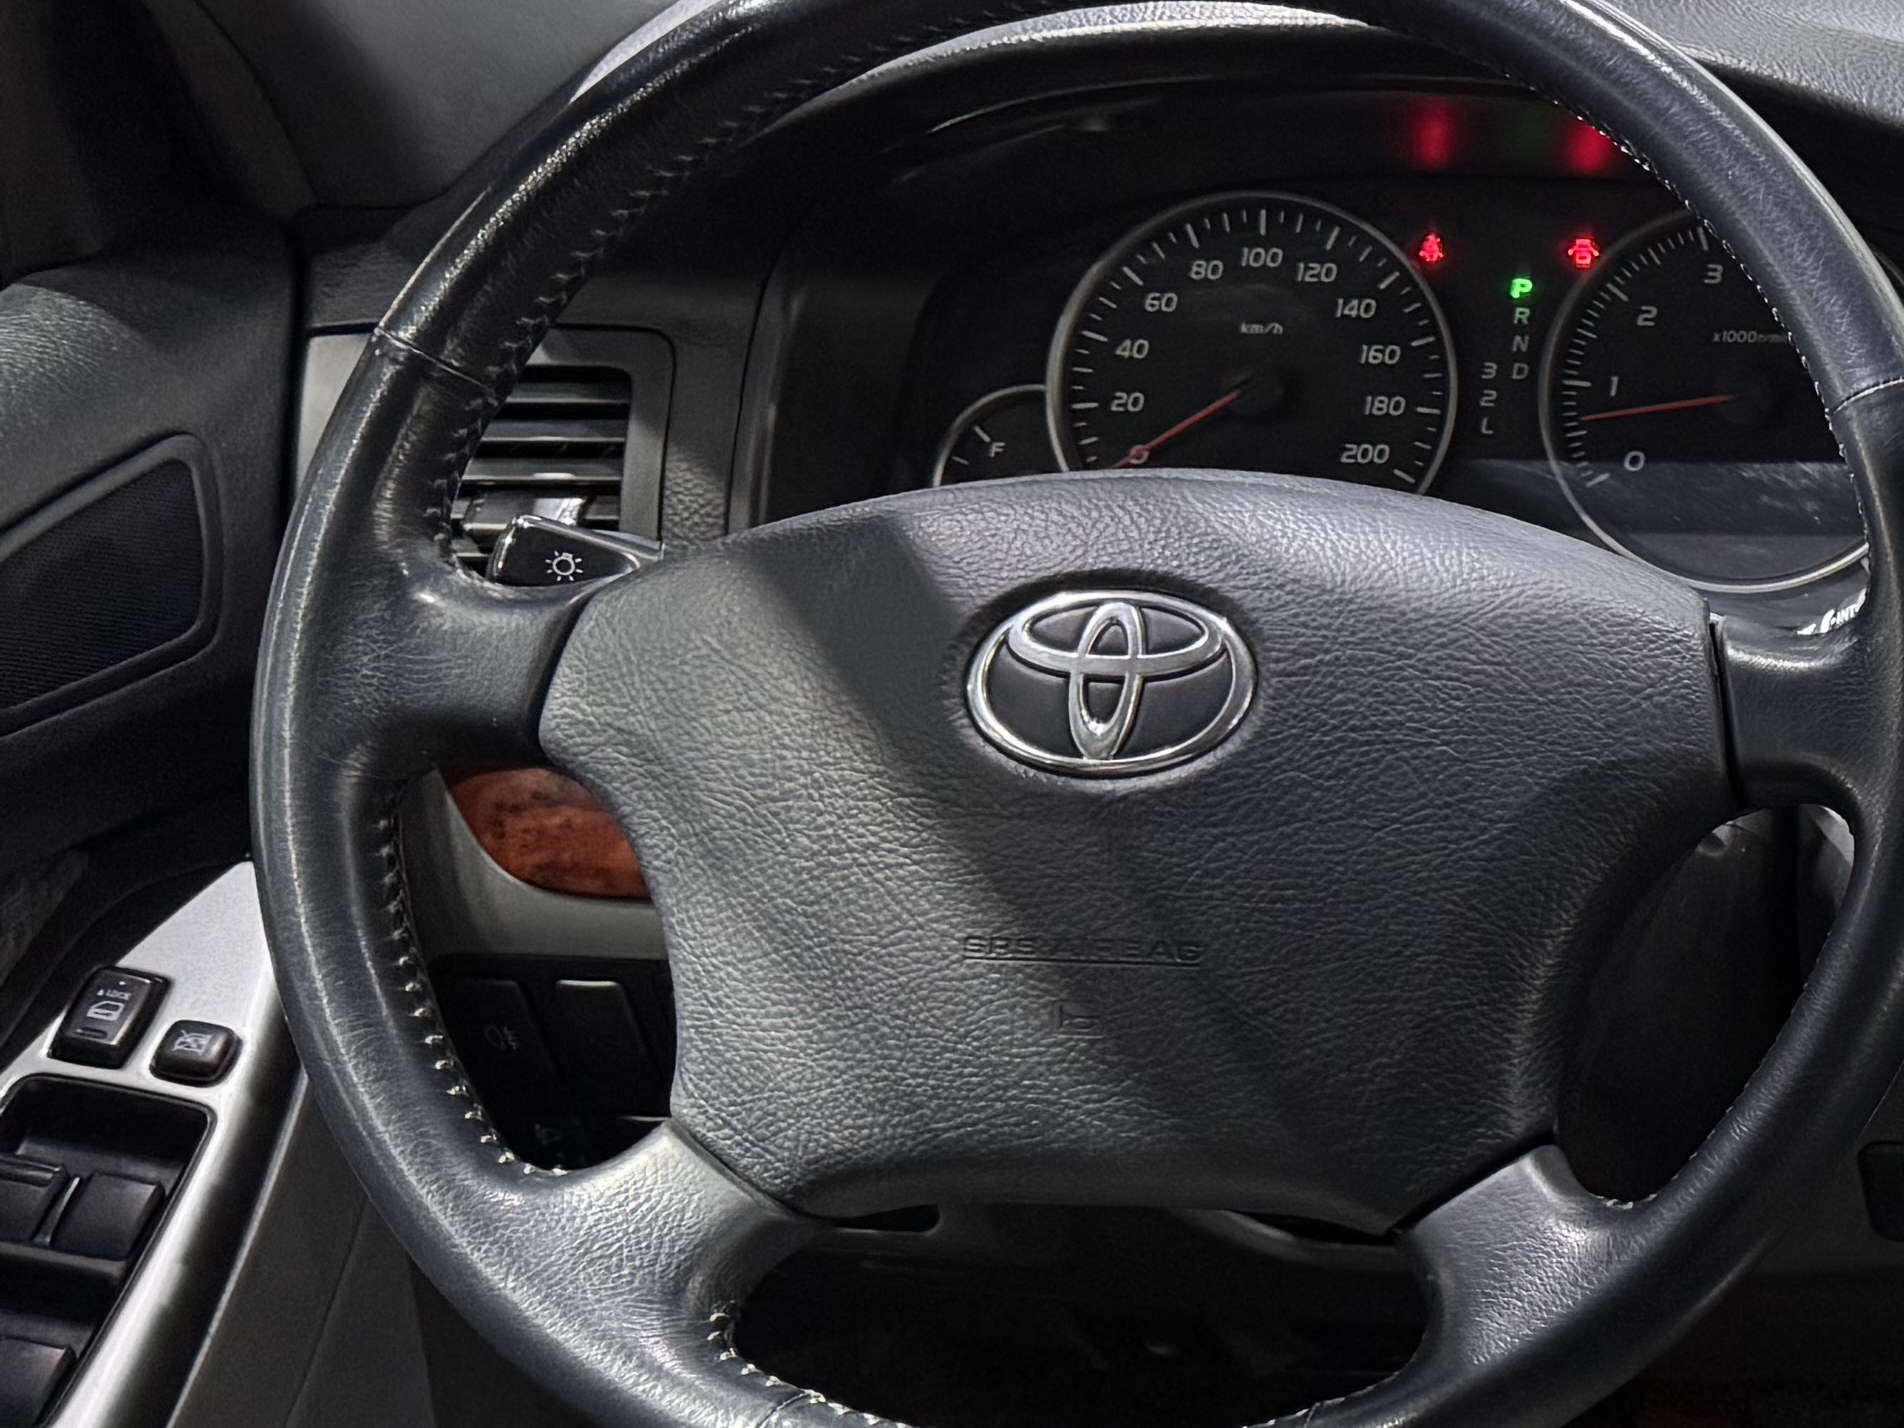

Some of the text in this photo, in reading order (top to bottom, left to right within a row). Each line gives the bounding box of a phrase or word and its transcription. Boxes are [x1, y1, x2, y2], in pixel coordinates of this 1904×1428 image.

[1241, 247, 1283, 268] 100
[1189, 260, 1224, 281] 80
[1297, 262, 1338, 283] 120
[1703, 263, 1724, 285] 3
[1510, 278, 1533, 299] P
[1144, 292, 1179, 313] 60
[1335, 298, 1378, 319] 140
[1513, 307, 1530, 325] R
[1636, 305, 1658, 327] 2
[1239, 321, 1284, 335] km/h
[1115, 338, 1150, 360] 40
[1512, 335, 1530, 352] N
[1359, 344, 1401, 365] 160
[1481, 362, 1498, 380] 3
[1511, 362, 1529, 380] D
[1609, 376, 1619, 397] 1
[1110, 391, 1145, 412] 20
[1364, 396, 1406, 416] 180
[1480, 390, 1497, 407] 2
[1481, 417, 1494, 434] L
[988, 441, 1006, 458] F
[1340, 443, 1390, 464] 200
[1623, 450, 1646, 472] 0
